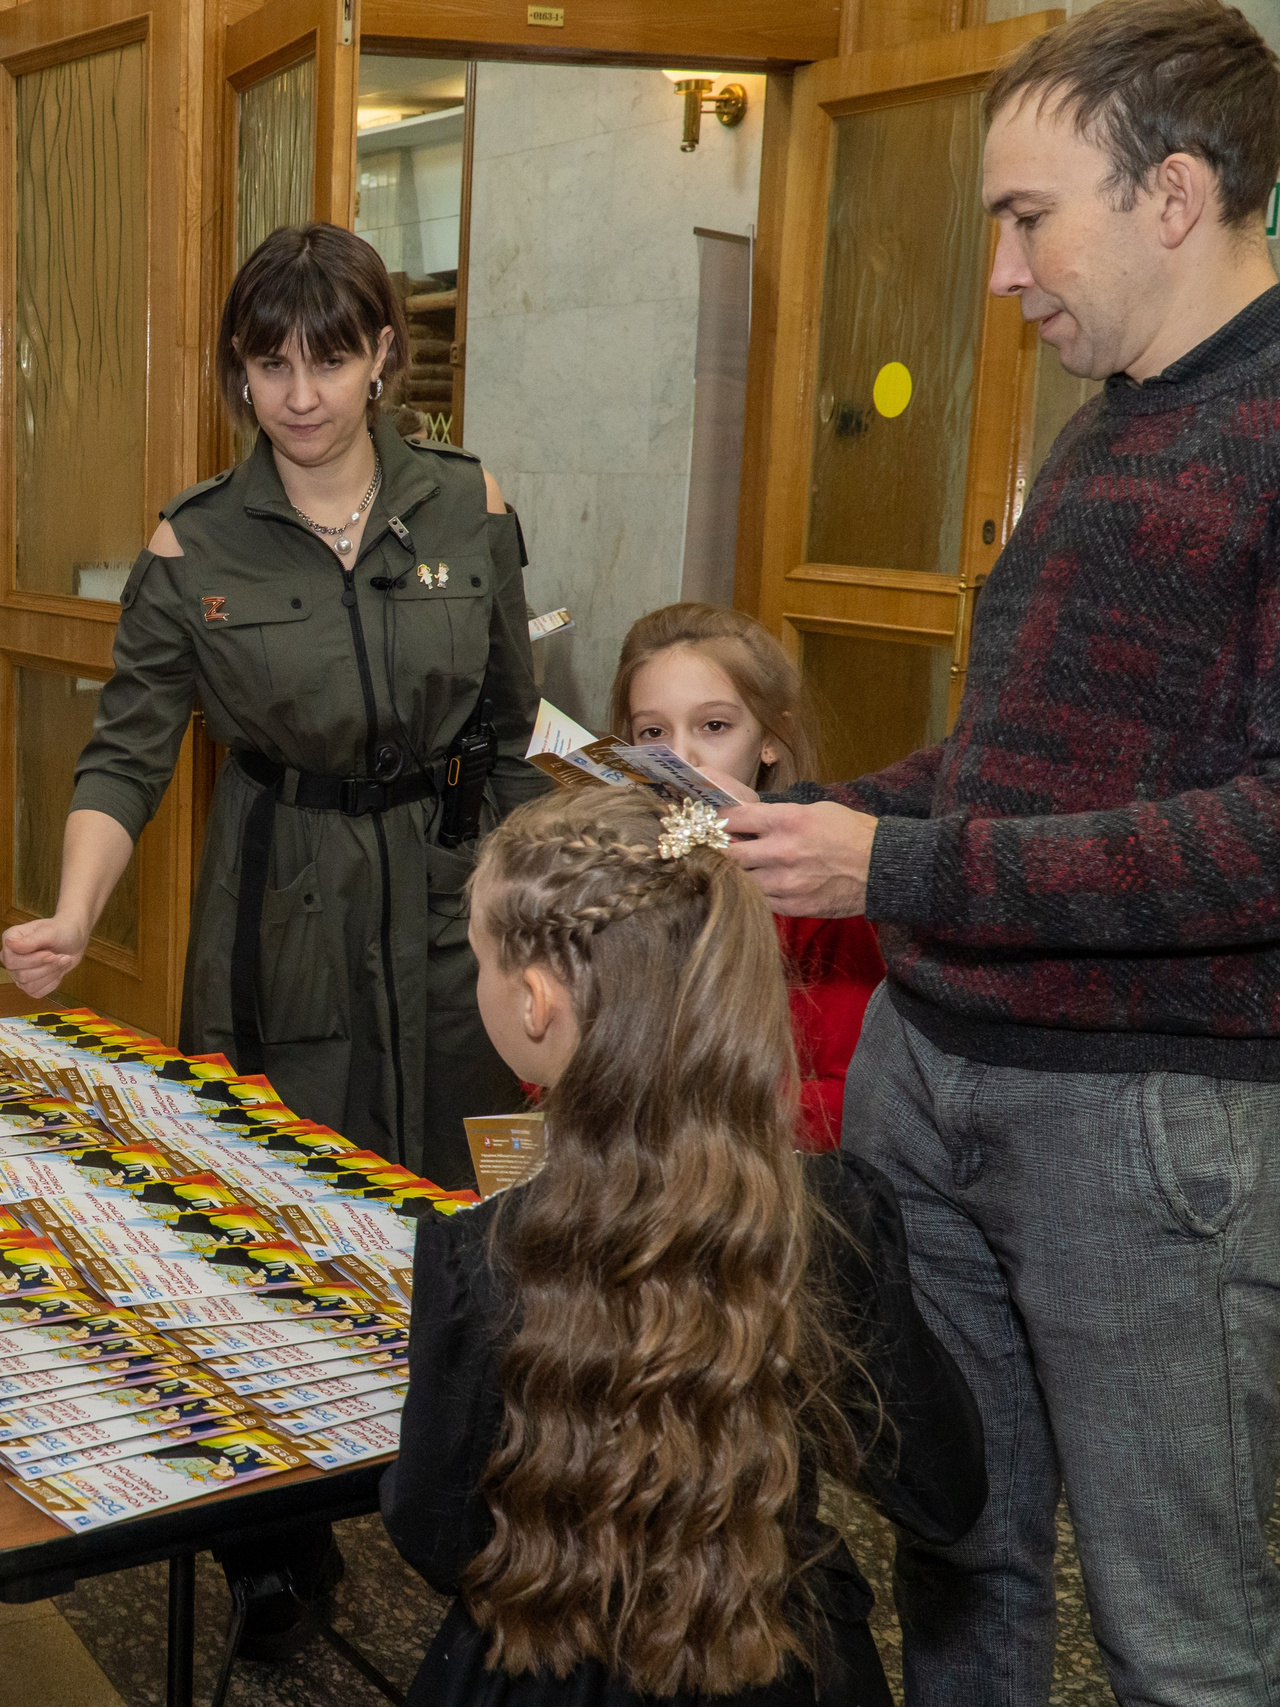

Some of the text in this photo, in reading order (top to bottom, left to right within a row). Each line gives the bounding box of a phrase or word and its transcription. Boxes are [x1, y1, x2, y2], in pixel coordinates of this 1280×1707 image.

[24, 1156, 56, 1196] ДЛЯ ДОМИСОЛЬКИ
[26, 1175, 44, 1197] КОНЦЕРТ
[42, 1164, 63, 1191] ОРКЕСТРОМ
[341, 1202, 384, 1251] ДЛЯ ДОМИСОЛЬКИ
[348, 1226, 372, 1252] КОНЦЕРТ
[362, 1212, 390, 1245] ОРКЕСТРОМ
[151, 1254, 193, 1295] ДЛЯ ДОМИСОЛЬКИ
[156, 1274, 179, 1297] КОНЦЕРТ
[171, 1262, 199, 1290] ОРКЕСТРОМ
[341, 1426, 385, 1449] КОНЦЕРТ
[375, 1433, 398, 1446] ДЛЯ
[114, 1464, 162, 1496] ОРКЕСТРОМ
[103, 1482, 144, 1509] КОНЦЕРТ
[136, 1491, 159, 1504] ДЛЯ
